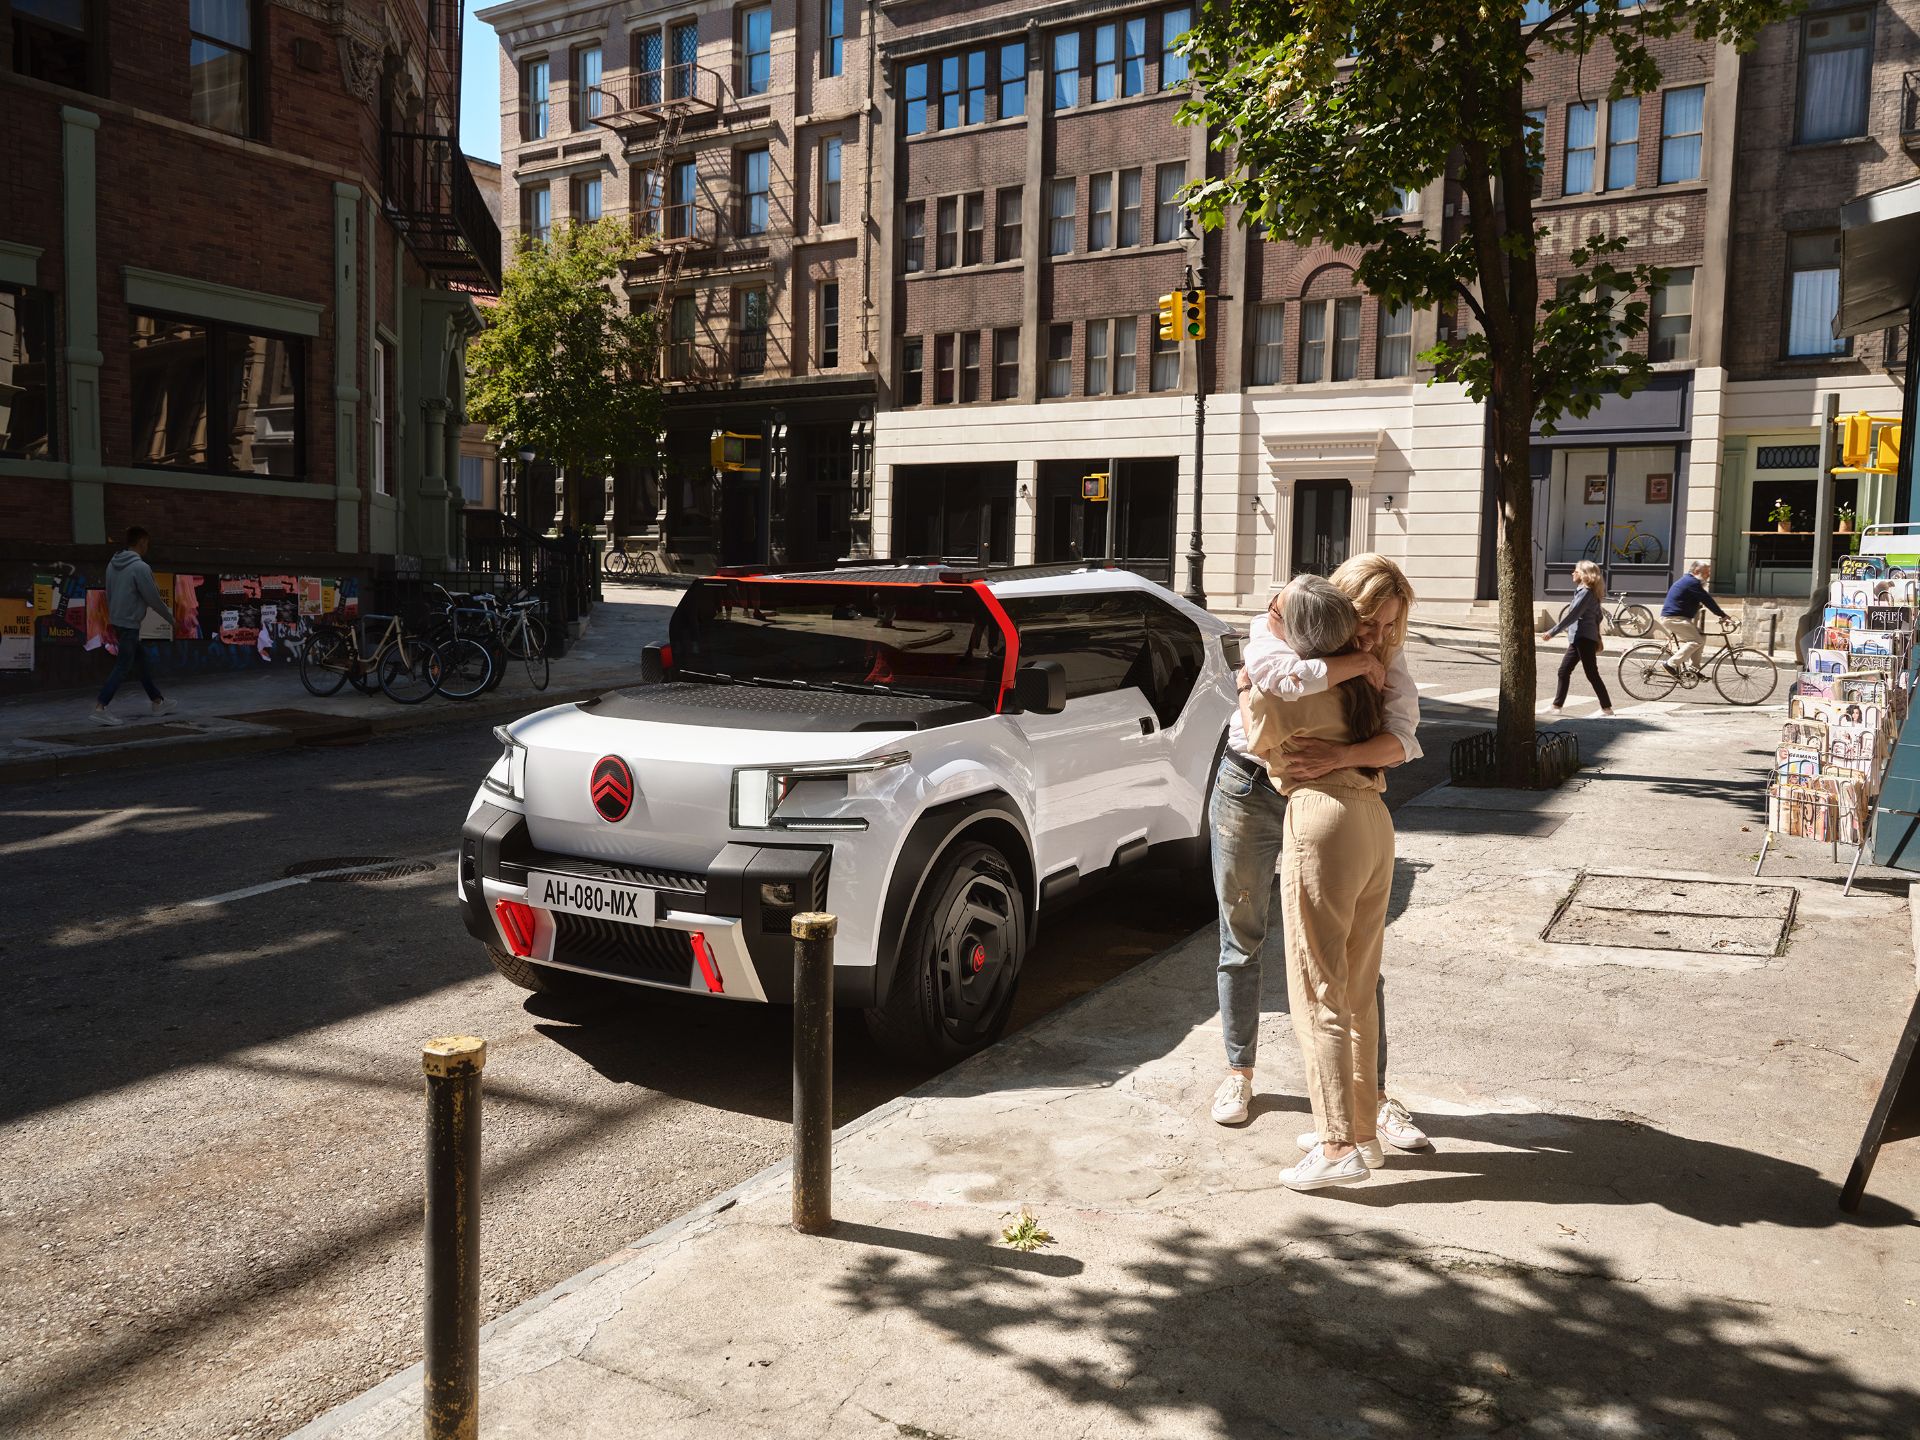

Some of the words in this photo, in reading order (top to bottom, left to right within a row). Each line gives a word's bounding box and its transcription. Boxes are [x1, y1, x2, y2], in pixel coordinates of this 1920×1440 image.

[1533, 203, 1686, 255] HOES
[16, 615, 30, 624] HUE
[3, 625, 18, 635] AND
[19, 625, 30, 634] ME
[48, 625, 74, 637] Music
[544, 879, 638, 918] AH-080-MX
